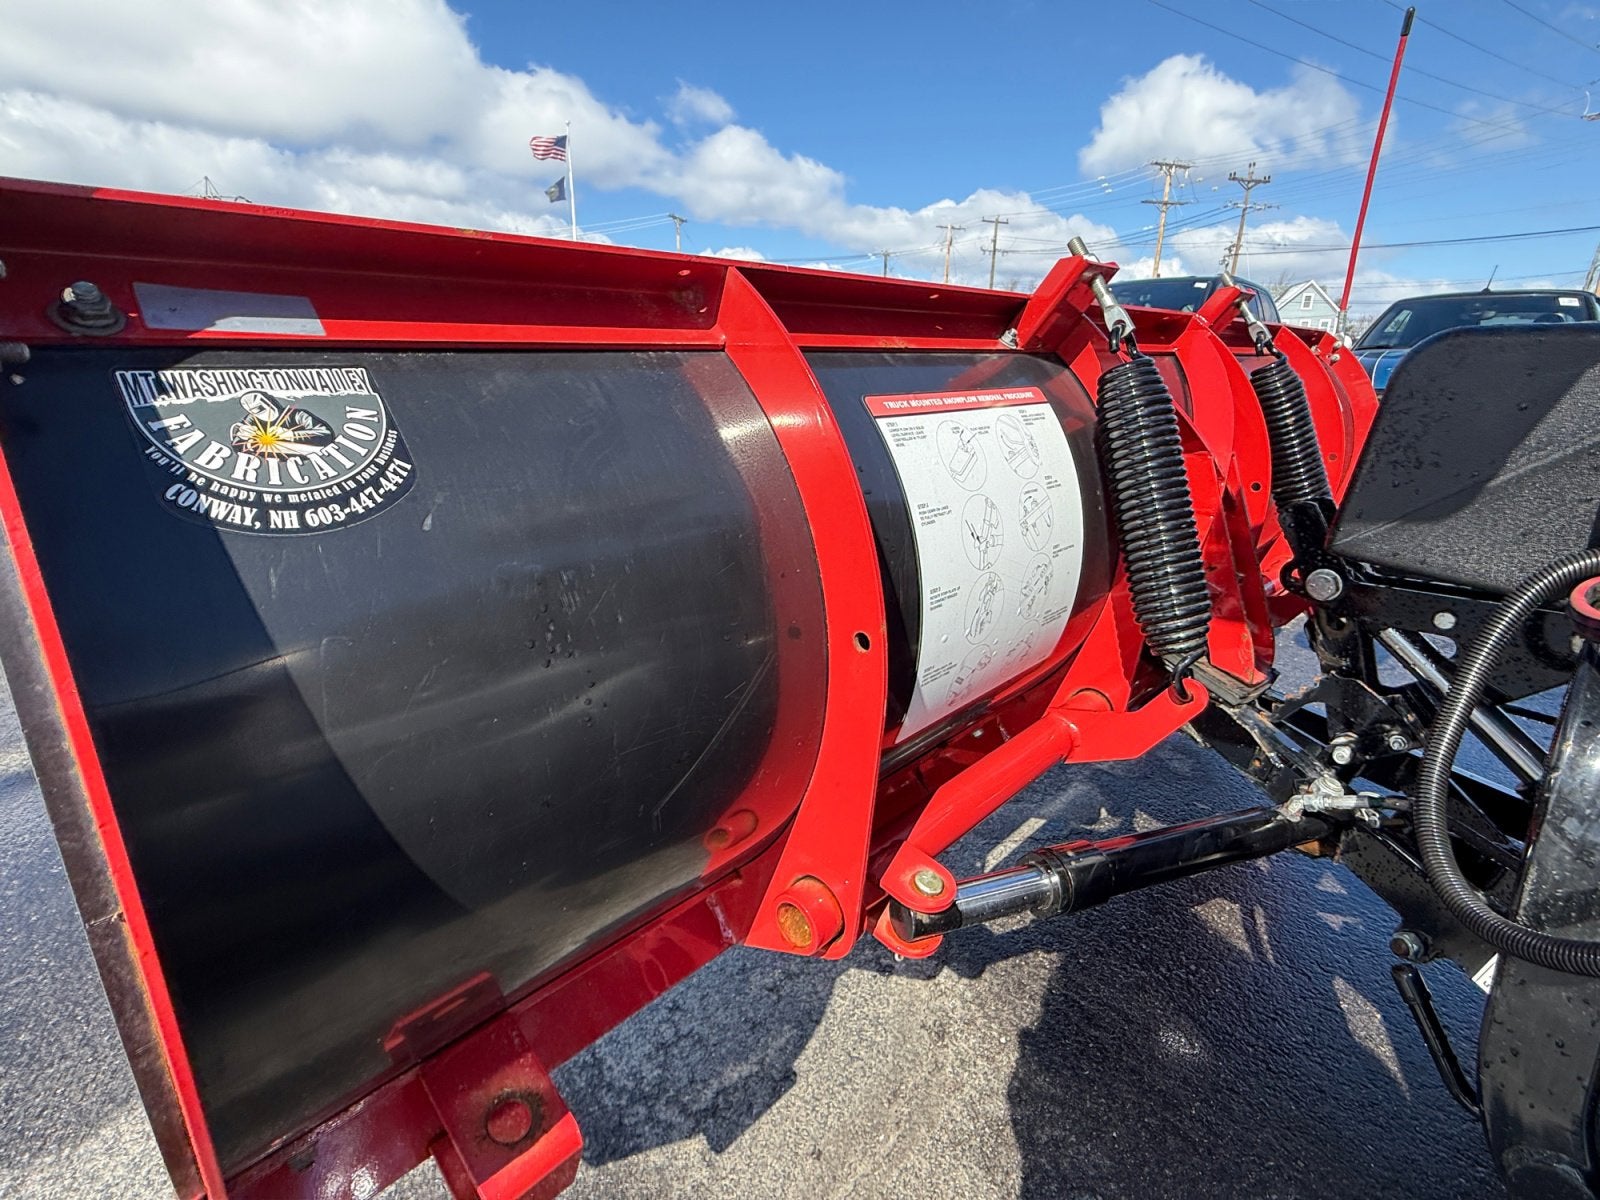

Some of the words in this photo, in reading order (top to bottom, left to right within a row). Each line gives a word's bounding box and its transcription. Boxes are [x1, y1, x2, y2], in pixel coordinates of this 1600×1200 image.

[158, 370, 302, 401] WASHINGTON
[301, 368, 372, 394] VALLEY
[883, 401, 911, 409] TRUCK
[910, 398, 943, 407] MOUNTED
[943, 396, 978, 405] SNOWPLOW
[977, 394, 1004, 403] REMOVAL
[1003, 392, 1035, 400] PROCEDURE
[144, 446, 185, 476] You'll
[187, 472, 205, 487] be
[210, 481, 257, 502] happy
[264, 493, 282, 503] we
[344, 480, 355, 490] in
[356, 464, 380, 485] your
[378, 429, 398, 469] business
[148, 406, 380, 485] FABRICATION
[164, 483, 261, 529] CONWAY,
[269, 510, 300, 529] NH
[305, 458, 412, 528] 603-447-4471
